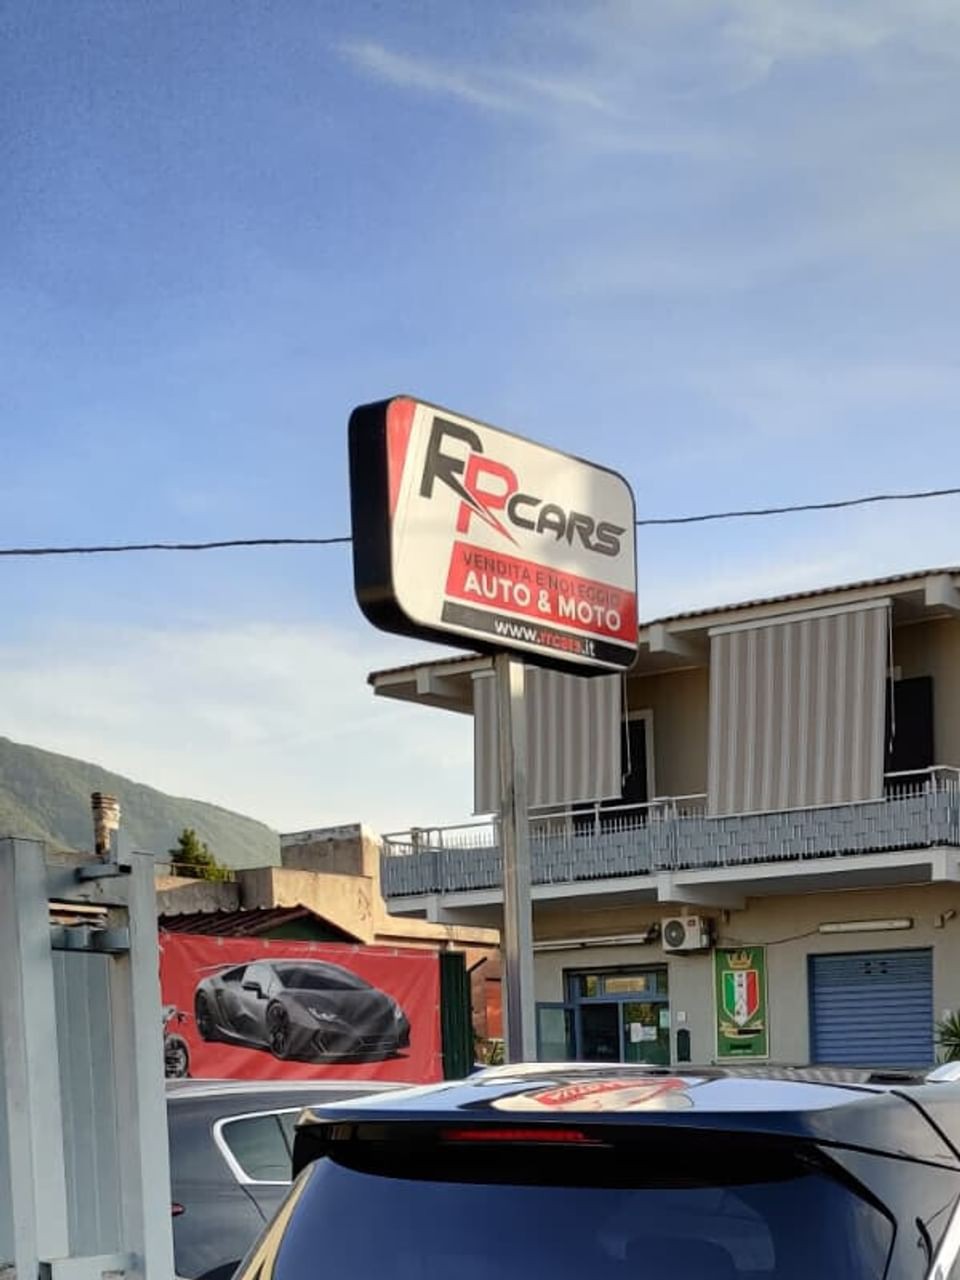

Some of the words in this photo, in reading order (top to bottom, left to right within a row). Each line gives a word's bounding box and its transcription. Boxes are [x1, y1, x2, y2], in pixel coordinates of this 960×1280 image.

[463, 551, 532, 581] VENDITA
[535, 571, 545, 586] E
[464, 570, 531, 607] AUTO
[537, 589, 552, 614] &
[558, 594, 621, 631] MOTO
[494, 619, 596, 657] www.rrcars.it
